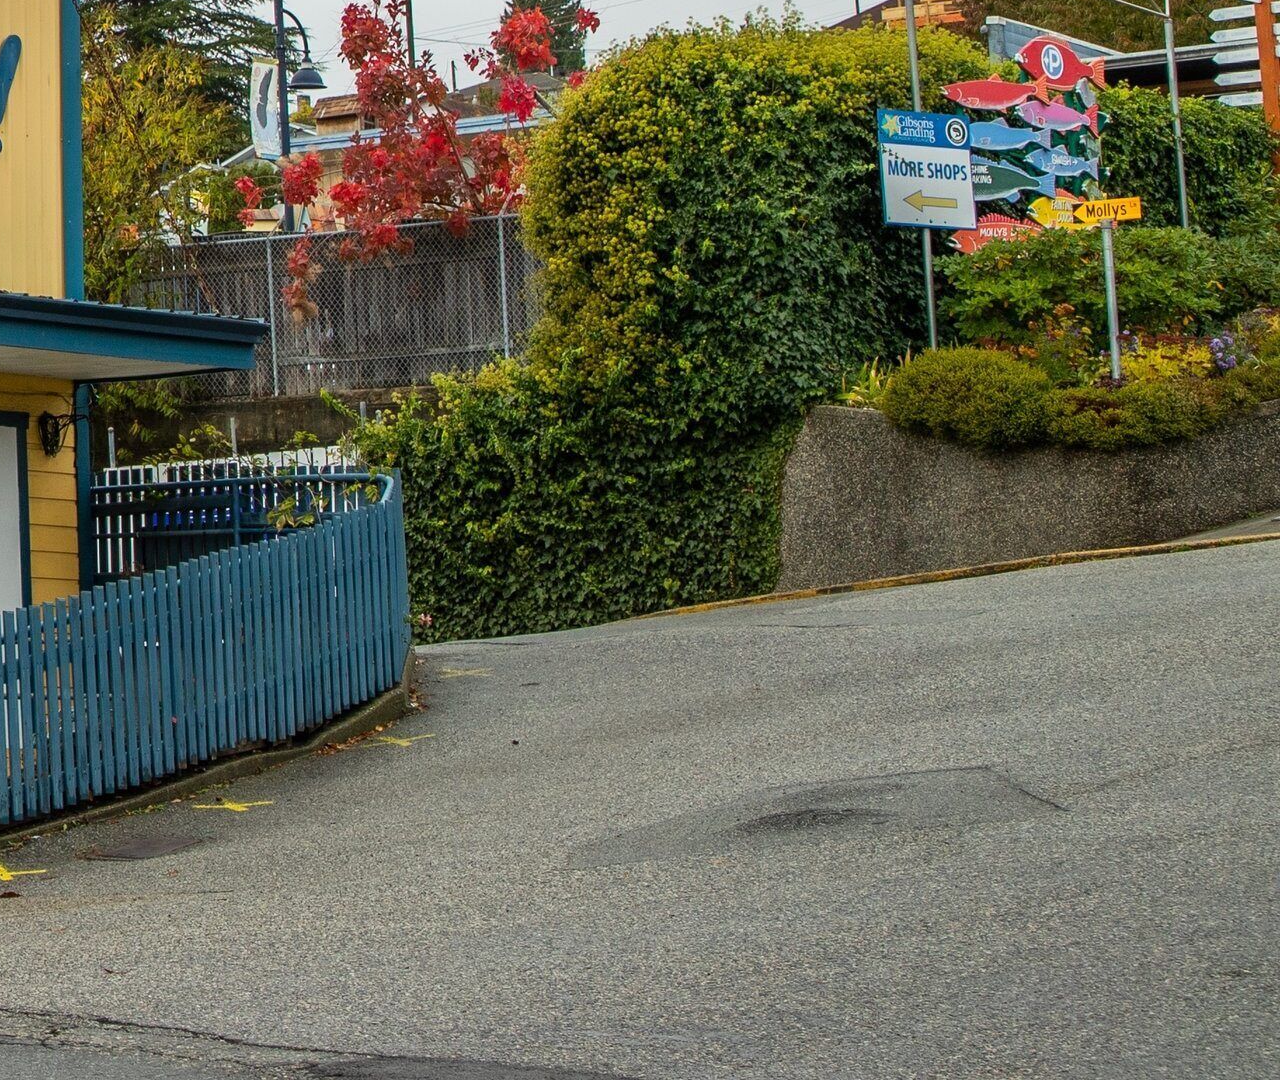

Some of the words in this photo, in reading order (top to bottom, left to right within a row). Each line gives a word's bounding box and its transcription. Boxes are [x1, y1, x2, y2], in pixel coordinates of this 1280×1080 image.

[896, 115, 934, 129] Gibsons
[897, 126, 935, 143] Landing
[888, 159, 924, 178] MORE
[927, 162, 968, 181] SHOPS
[1086, 203, 1127, 220] Mollys
